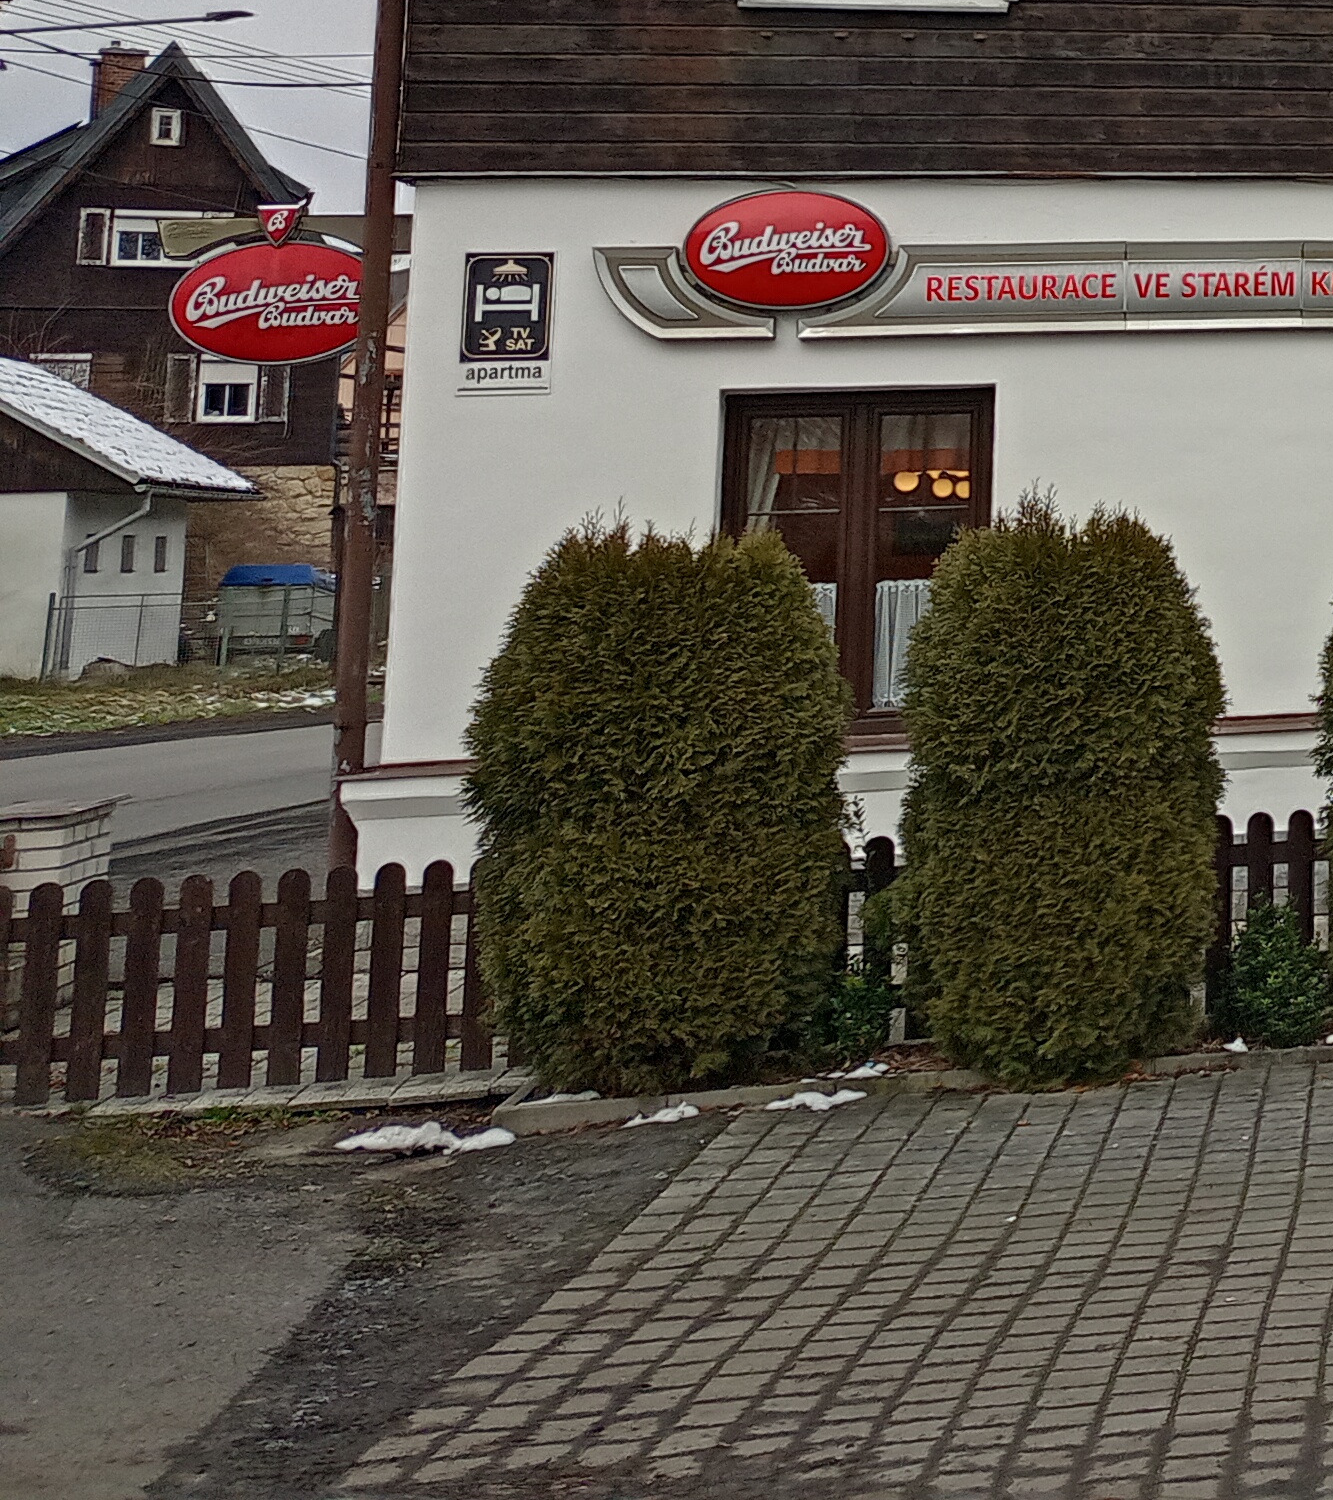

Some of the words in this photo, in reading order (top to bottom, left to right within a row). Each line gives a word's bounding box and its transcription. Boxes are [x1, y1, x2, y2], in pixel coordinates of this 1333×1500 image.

[700, 221, 872, 266] Budweiser
[771, 248, 867, 275] Budvar
[925, 272, 1118, 303] RESTAURACE
[1133, 271, 1171, 299] VE
[1180, 264, 1296, 298] STARÉM
[185, 273, 360, 322] Budweiser
[257, 302, 360, 330] Budvar
[505, 339, 536, 351] SAT
[510, 327, 531, 339] TV
[465, 363, 543, 384] apartma
